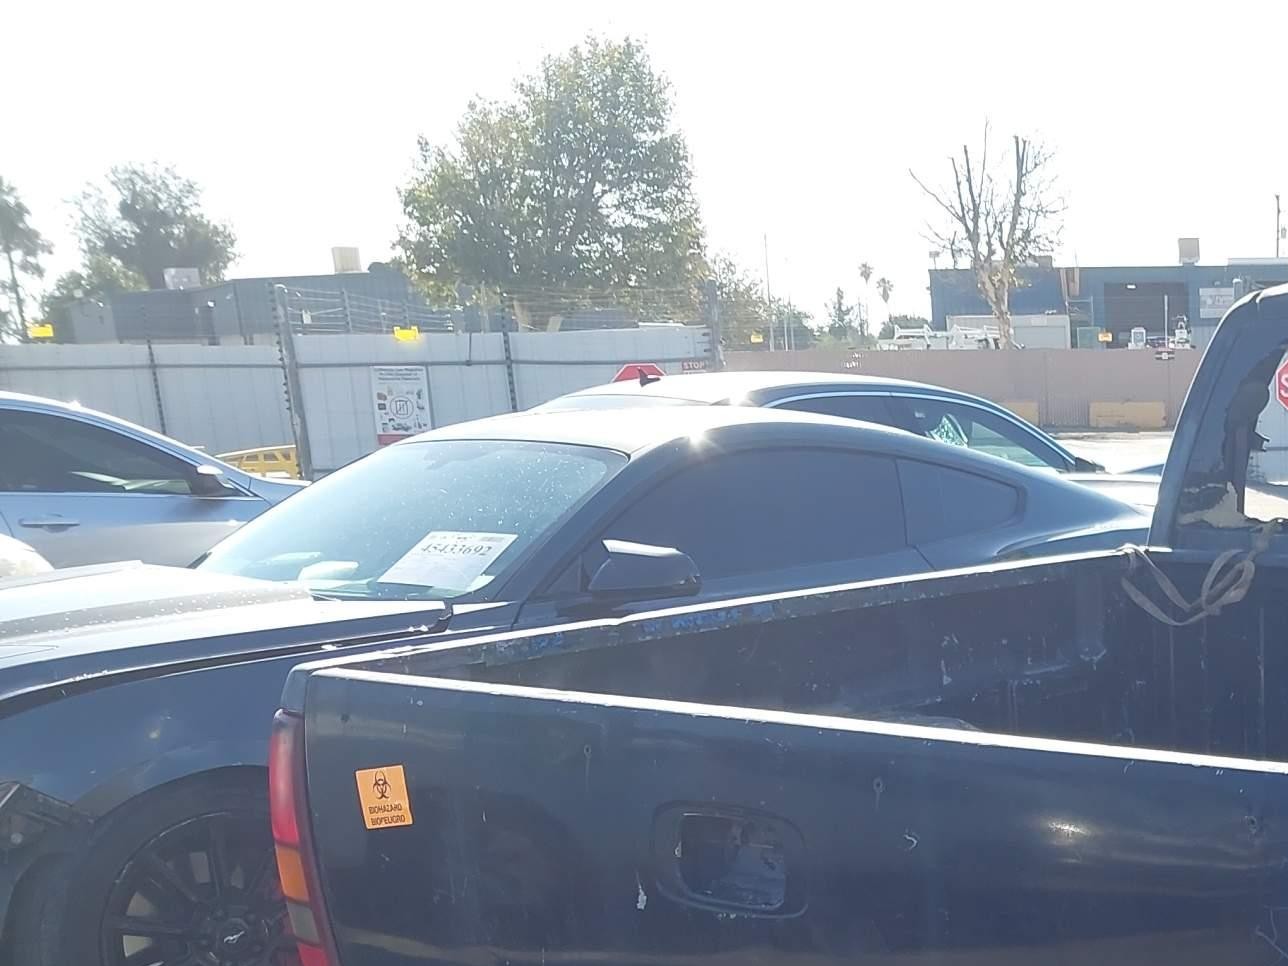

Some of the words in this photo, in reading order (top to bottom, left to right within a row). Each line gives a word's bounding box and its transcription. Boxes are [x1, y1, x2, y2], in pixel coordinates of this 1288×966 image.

[682, 361, 705, 370] STOP
[368, 803, 403, 814] BIOHAZARD
[371, 815, 406, 826] BIOPELIGRO
